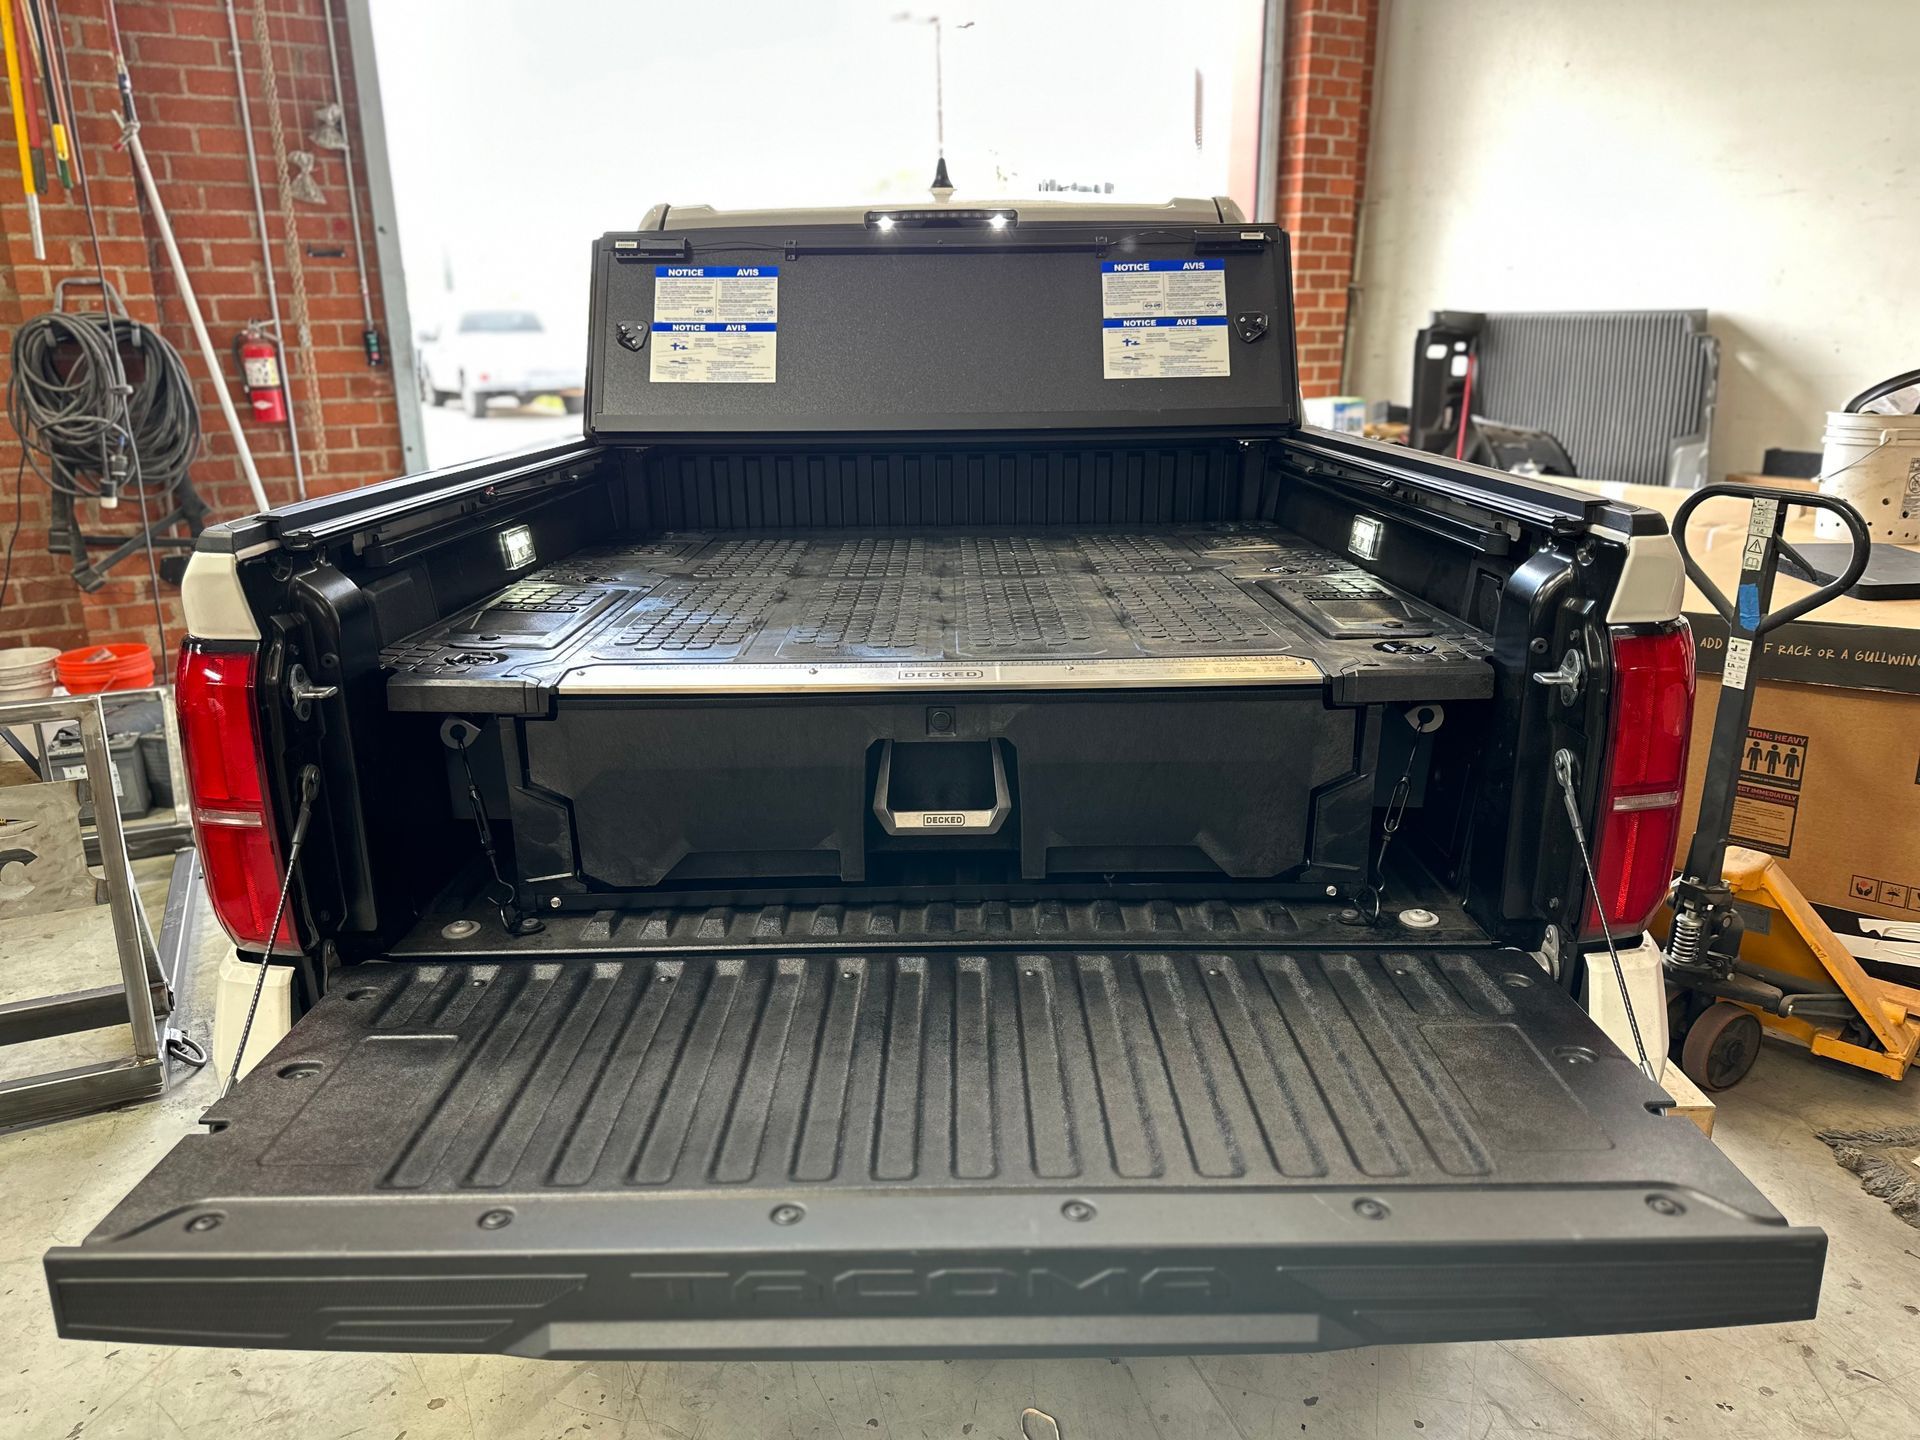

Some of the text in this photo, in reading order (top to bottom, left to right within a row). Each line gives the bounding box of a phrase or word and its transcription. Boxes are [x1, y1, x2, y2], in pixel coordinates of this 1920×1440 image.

[1114, 263, 1150, 272] NOTICE
[1183, 262, 1205, 270] AVIS
[668, 268, 704, 277] NOTICE
[736, 268, 759, 276] AVIS
[1123, 319, 1157, 327] NOTICE
[1176, 318, 1197, 326] AVIS
[672, 324, 706, 332] NOTICE
[725, 324, 747, 332] AVIS
[1700, 637, 1723, 650] ADD
[1778, 644, 1812, 657] RACK
[1817, 647, 1835, 659] OR
[1841, 648, 1849, 660] A
[1748, 730, 1807, 745] TION: HEAVY
[1750, 788, 1797, 801] IMMEDIATELY
[926, 816, 963, 824] DECKED
[629, 1265, 1233, 1304] TACOMA
